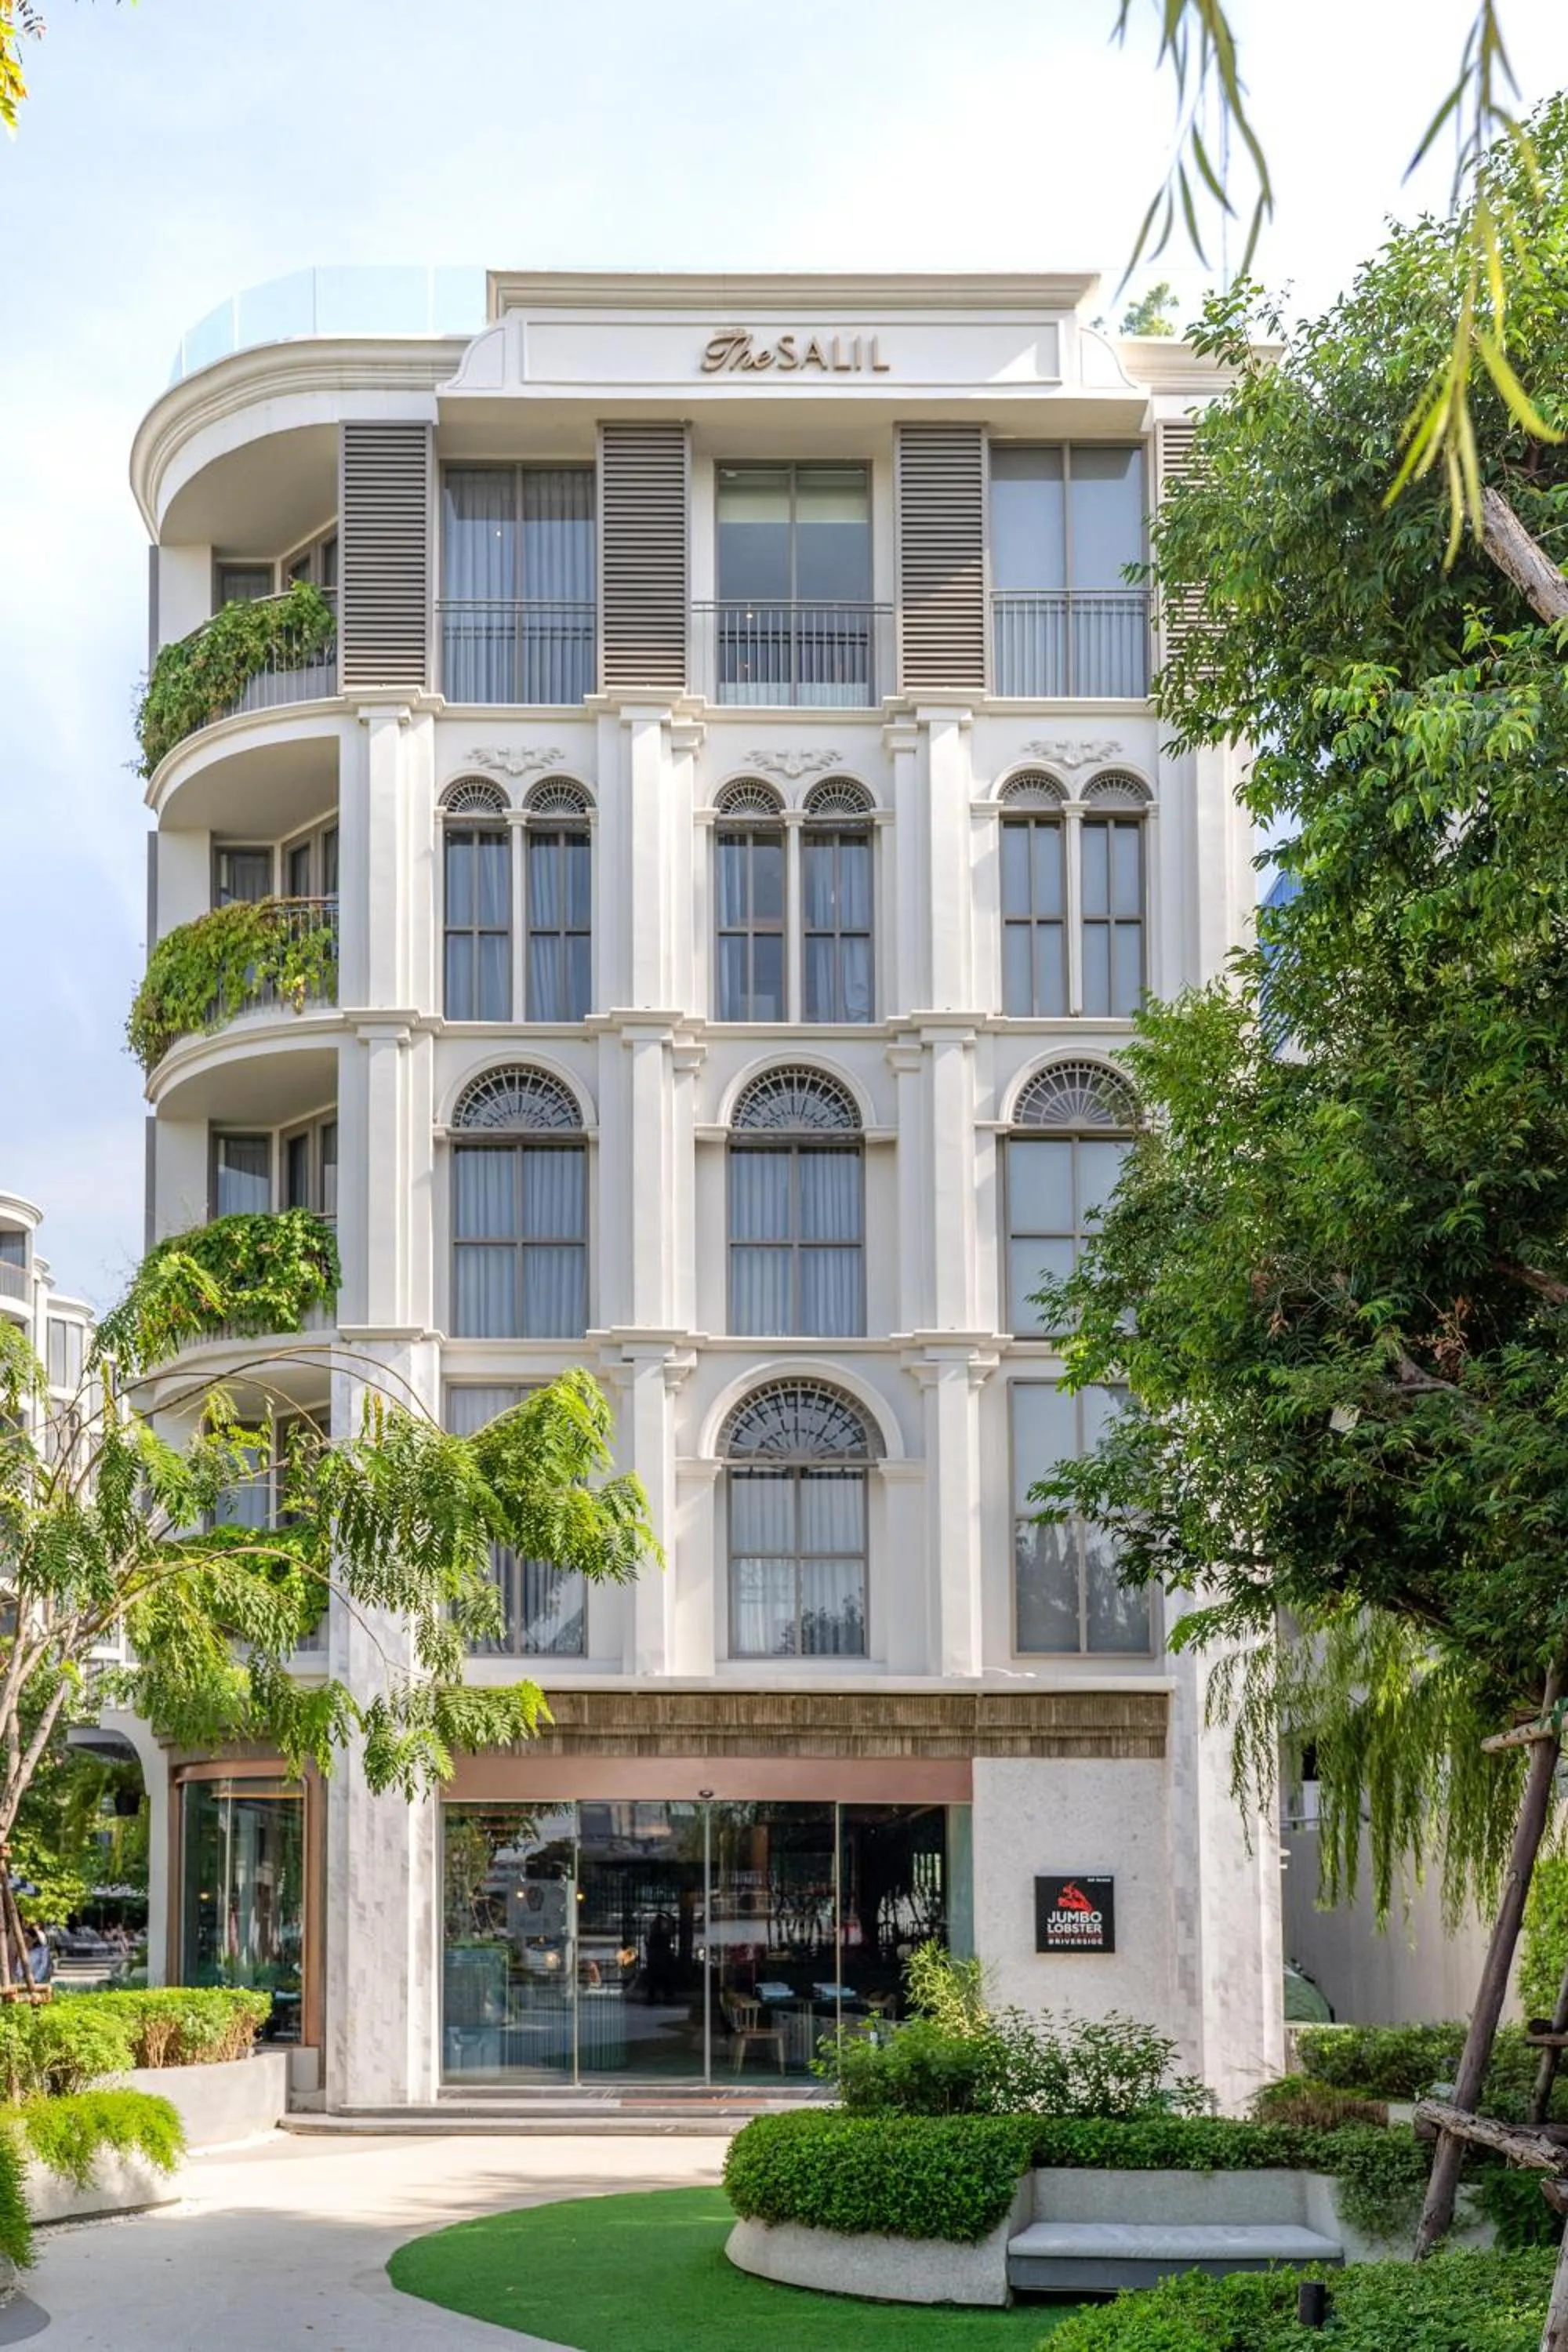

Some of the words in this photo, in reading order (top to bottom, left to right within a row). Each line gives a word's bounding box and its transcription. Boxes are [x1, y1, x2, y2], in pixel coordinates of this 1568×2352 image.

[700, 332, 776, 372] The
[777, 335, 891, 372] SALIL
[1047, 1911, 1102, 1923] JUMBO
[1047, 1924, 1102, 1933] LOBSTER
